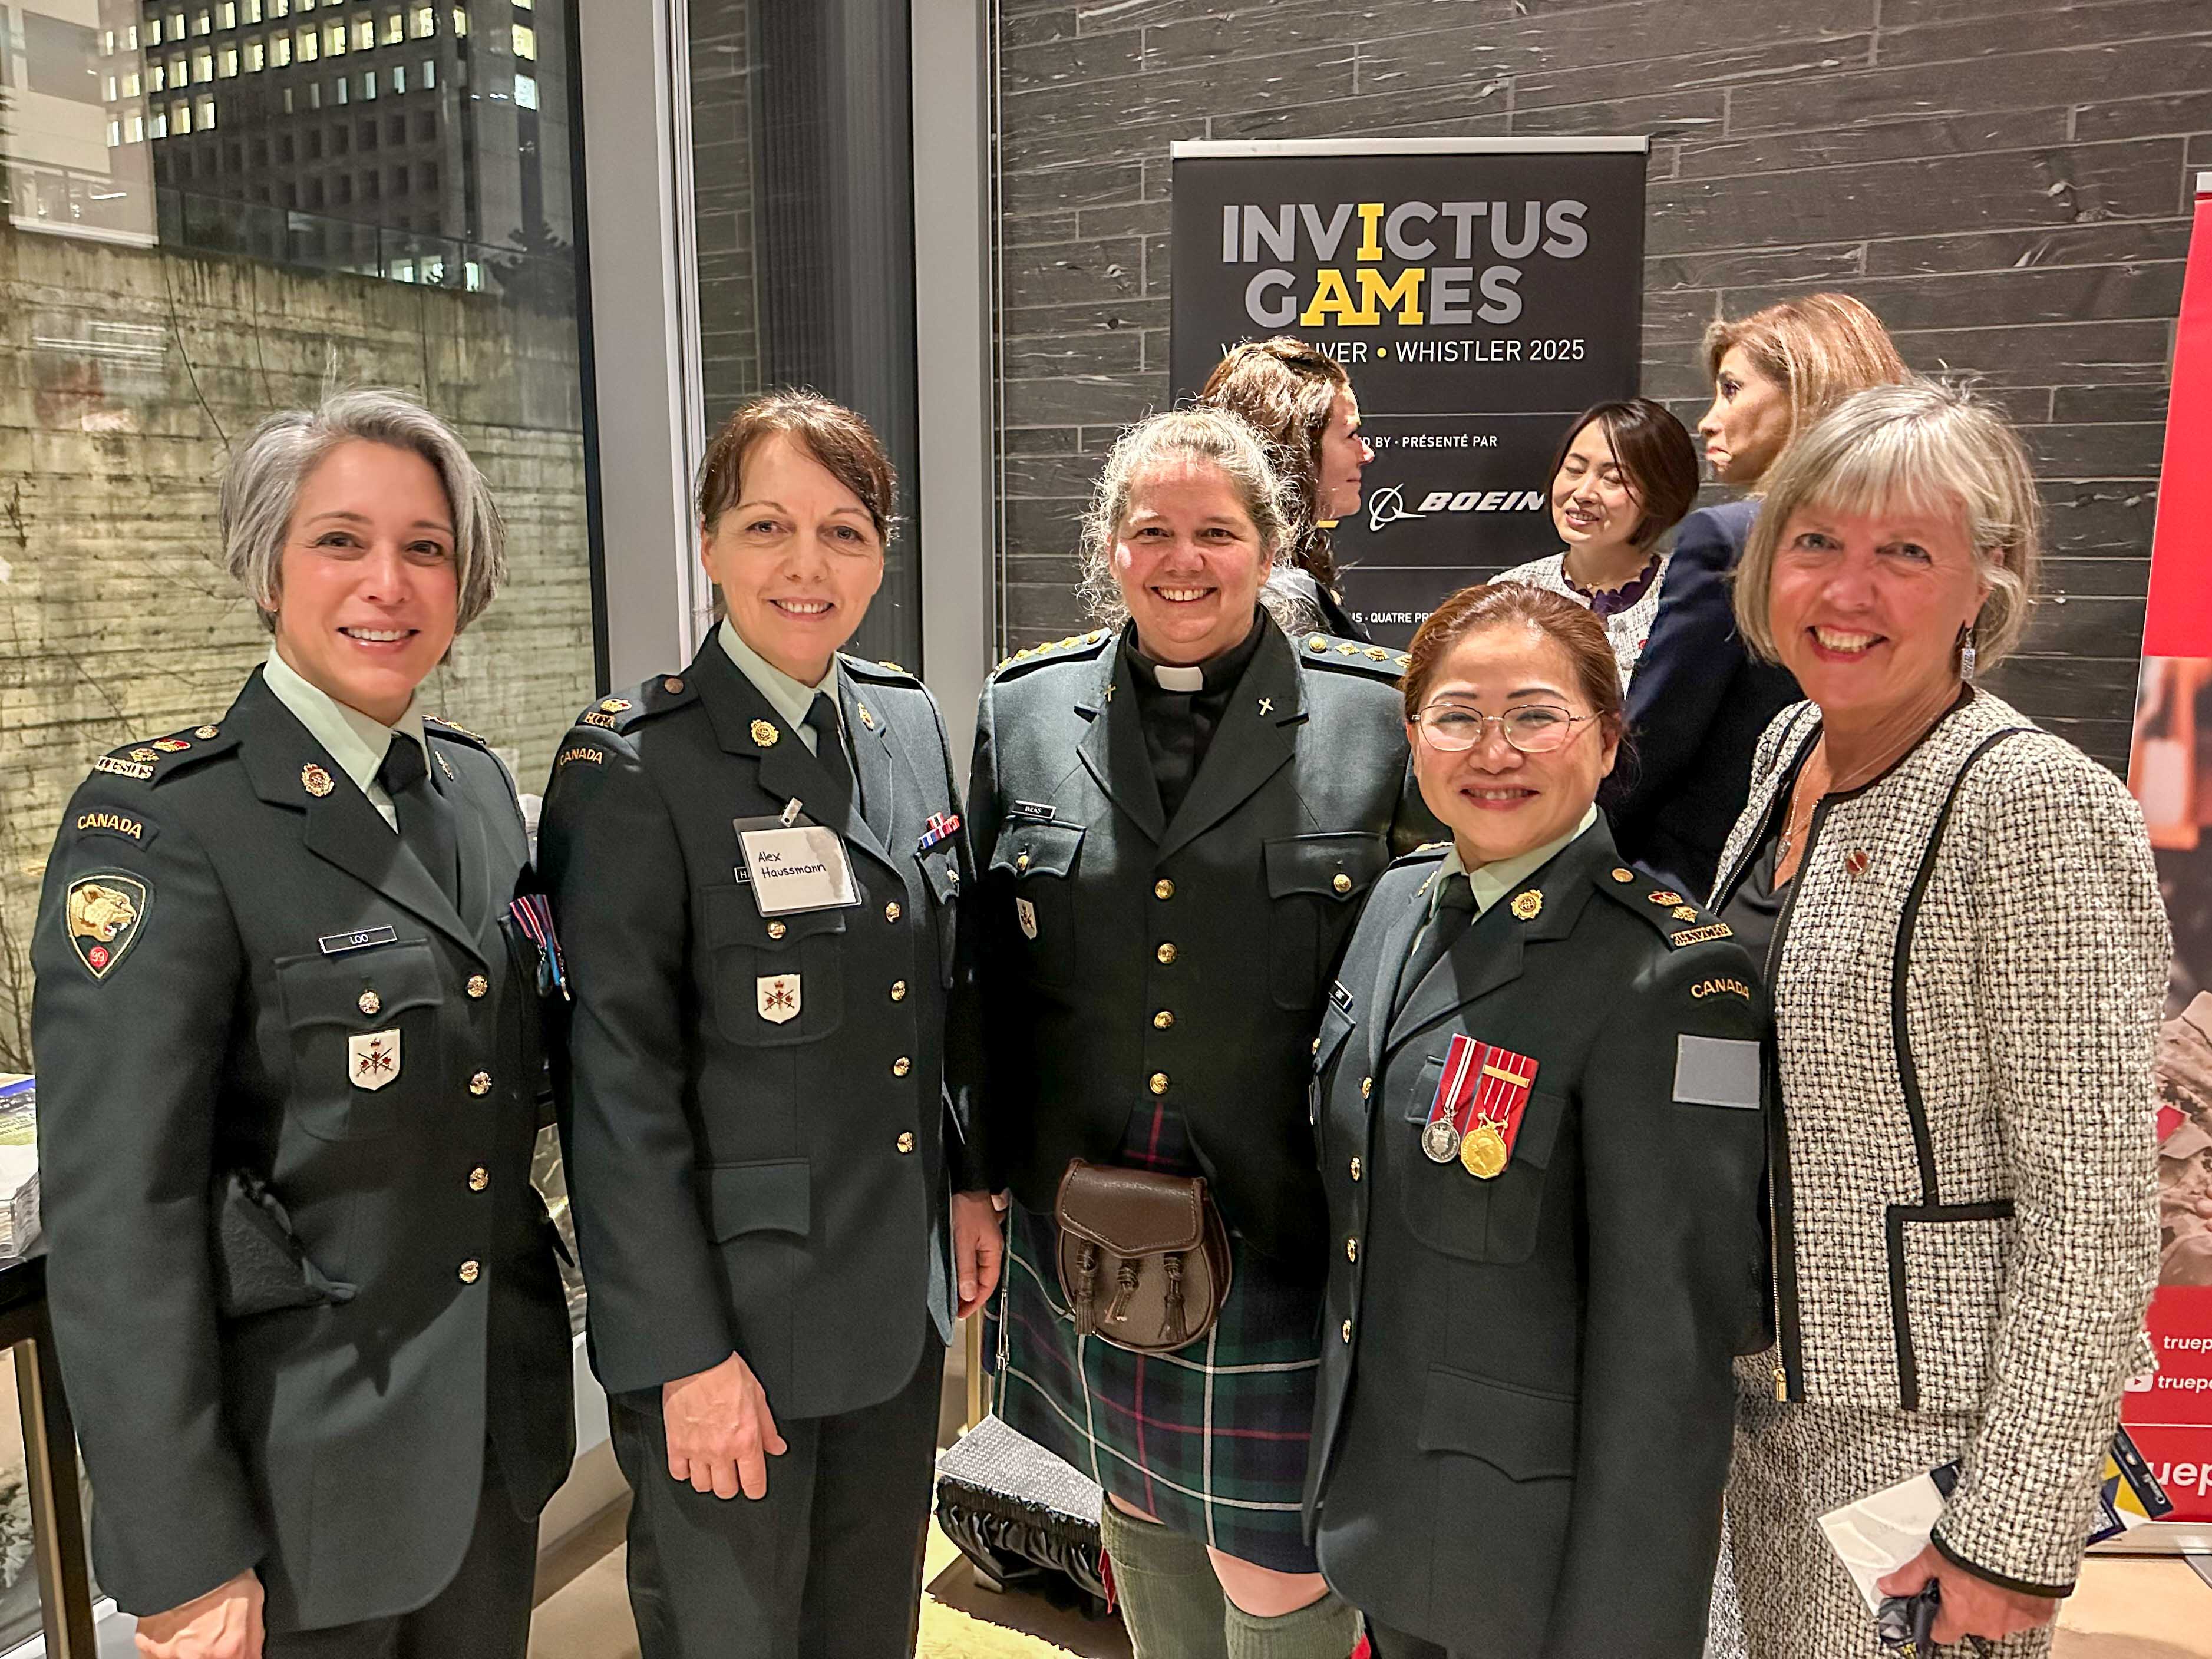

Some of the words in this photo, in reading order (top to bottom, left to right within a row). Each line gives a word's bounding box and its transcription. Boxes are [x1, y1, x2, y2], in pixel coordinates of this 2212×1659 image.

[1223, 200, 1588, 262] INVICTUS
[1245, 265, 1523, 328] GAMES
[1395, 340, 1521, 362] WHISTLER
[1529, 339, 1585, 361] 2025
[1375, 437, 1391, 448] BY
[1402, 434, 1468, 448] PRÉSENTÉ
[1473, 435, 1497, 447] PAR
[1417, 491, 1546, 511] BOEIN
[1371, 613, 1412, 623] QUATRE
[560, 748, 603, 766] CANADA
[77, 813, 143, 840] CANADA
[758, 851, 781, 862] Alex
[762, 864, 826, 878] Haussmann
[349, 934, 369, 944] LOO
[1691, 978, 1749, 1000] CANADA
